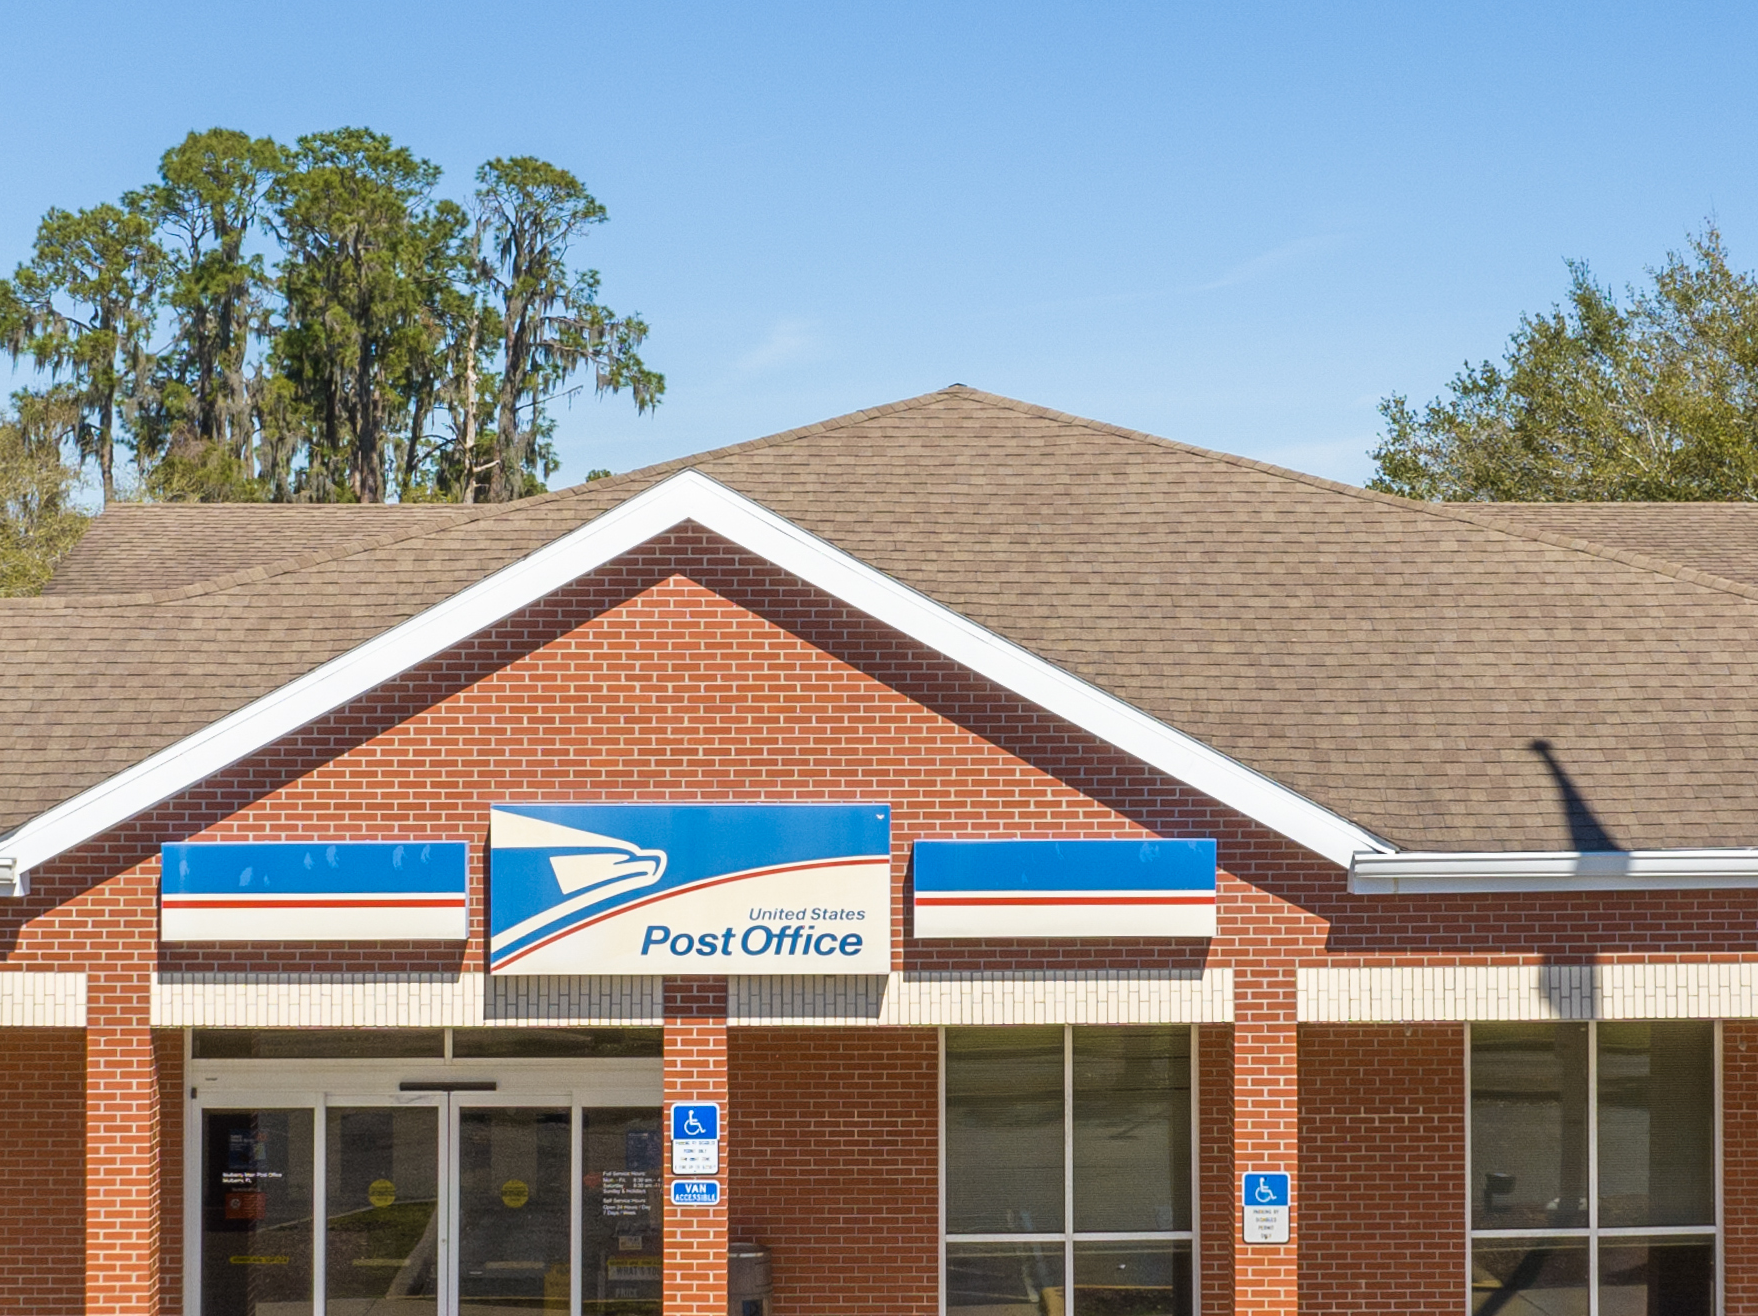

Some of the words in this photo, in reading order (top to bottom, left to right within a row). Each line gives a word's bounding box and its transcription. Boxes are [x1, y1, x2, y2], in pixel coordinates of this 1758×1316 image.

[749, 907, 806, 921] United
[810, 907, 866, 921] States
[641, 925, 735, 956] Post
[742, 924, 863, 956] Office
[685, 1184, 707, 1193] VAN
[675, 1194, 716, 1202] ACCESSIBLE
